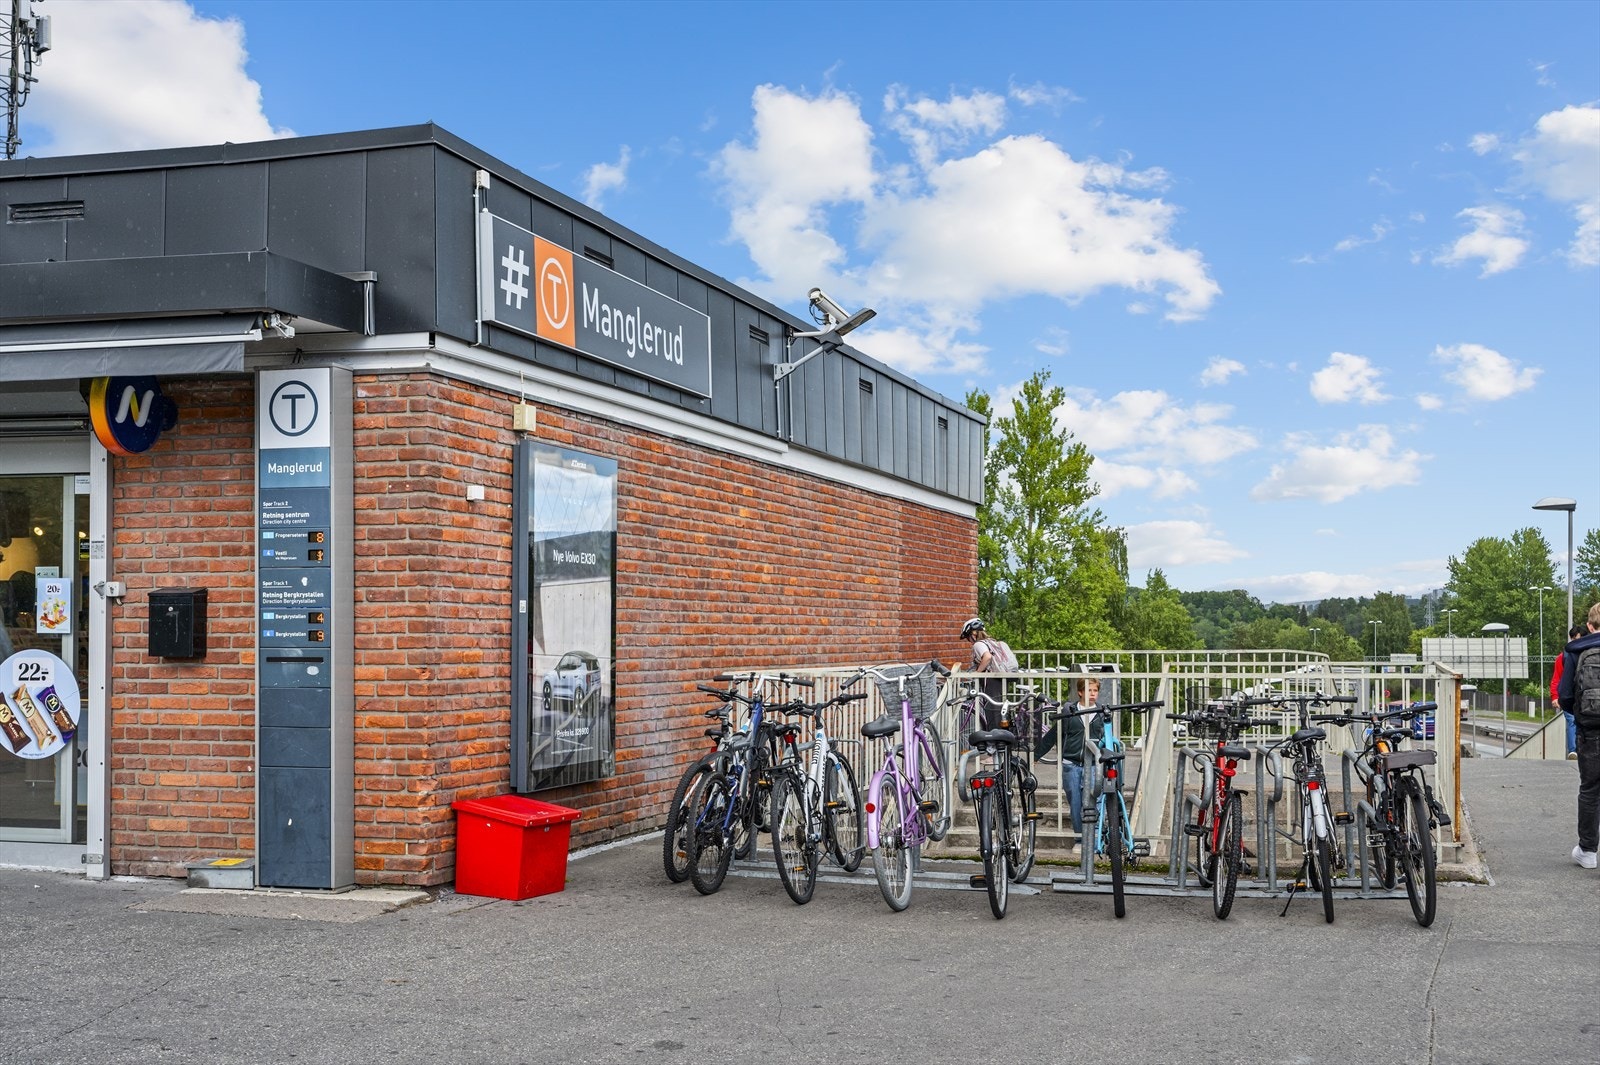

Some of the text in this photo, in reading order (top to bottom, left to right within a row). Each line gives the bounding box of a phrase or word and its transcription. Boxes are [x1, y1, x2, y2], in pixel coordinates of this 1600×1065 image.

[582, 282, 684, 367] Manglerud
[267, 462, 323, 476] Manglerud
[316, 532, 324, 543] 8
[553, 549, 596, 565] Nye Volvo EX30
[283, 591, 324, 599] Bergkrystallen
[316, 613, 324, 623] 4
